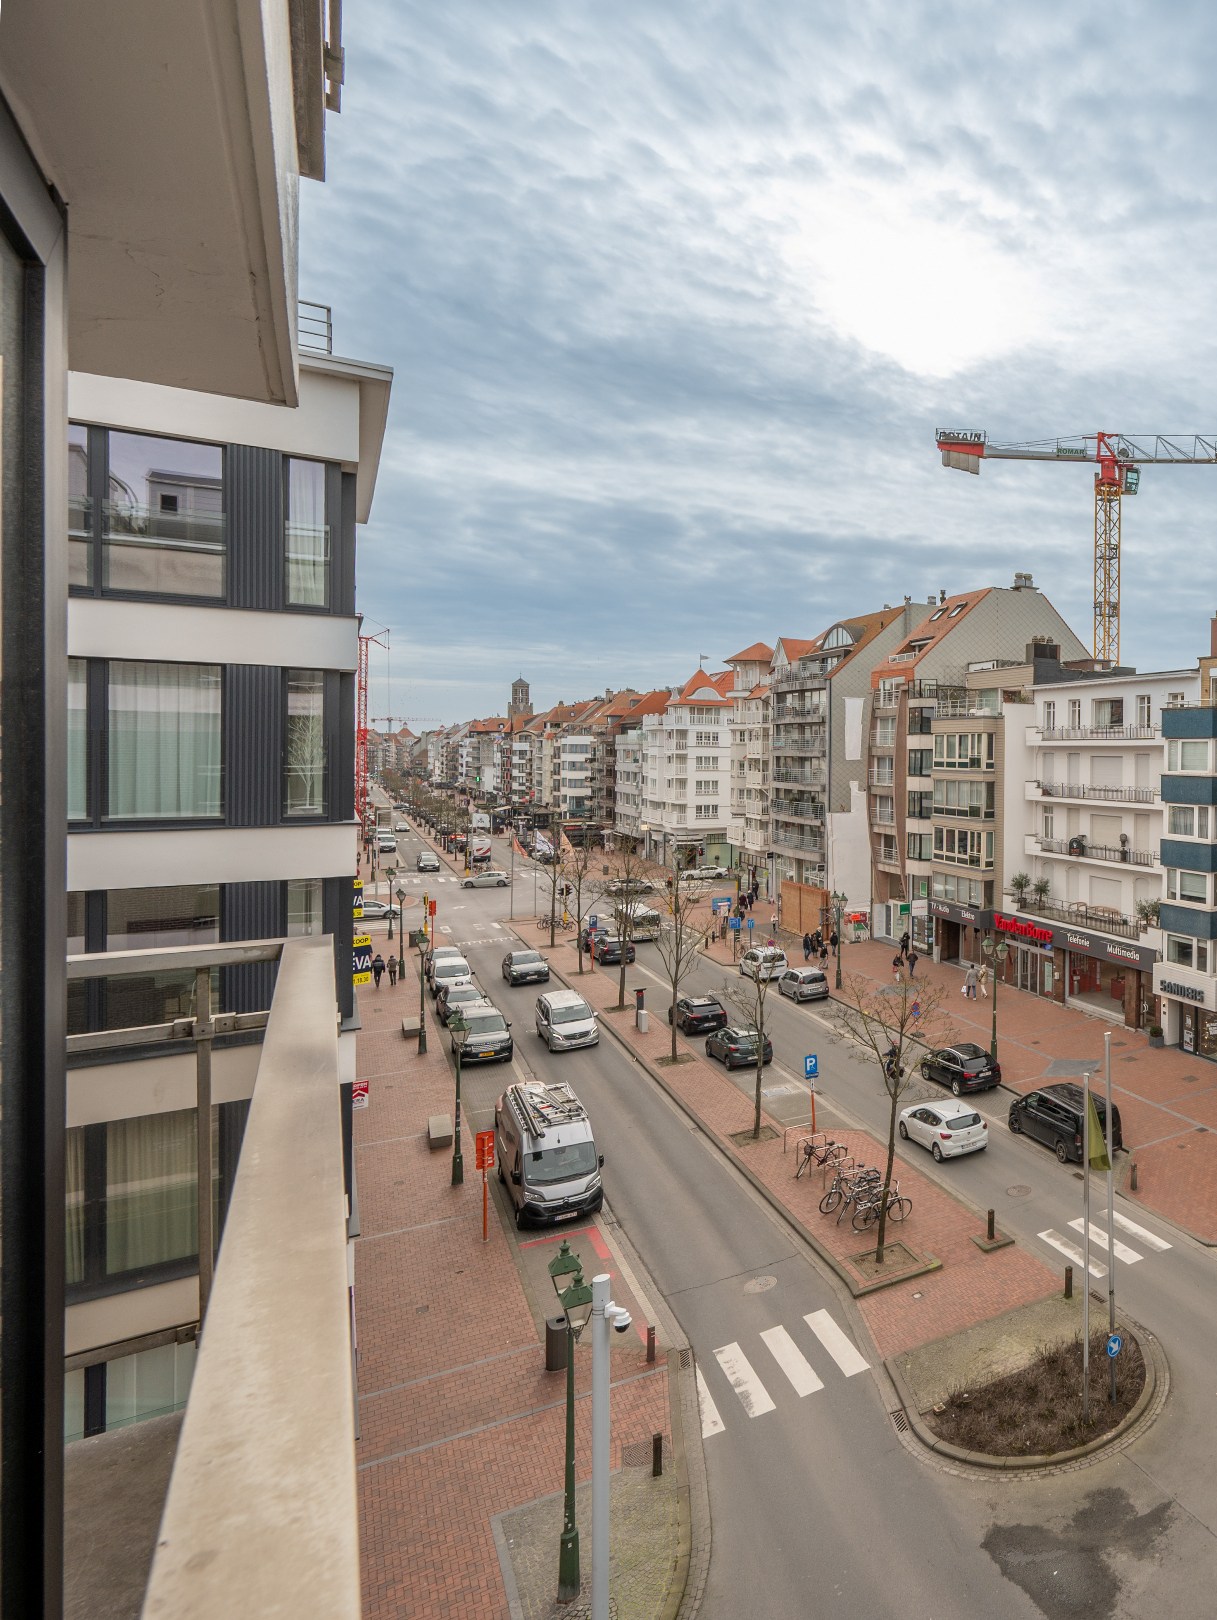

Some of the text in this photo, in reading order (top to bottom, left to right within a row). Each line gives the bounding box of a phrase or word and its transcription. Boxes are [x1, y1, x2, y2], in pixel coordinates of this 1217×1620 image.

[590, 916, 597, 925] P
[1066, 933, 1090, 948] Telefonie
[1106, 943, 1140, 961] Multimedia
[1160, 980, 1205, 1003] SANDERS
[806, 1057, 816, 1071] P
